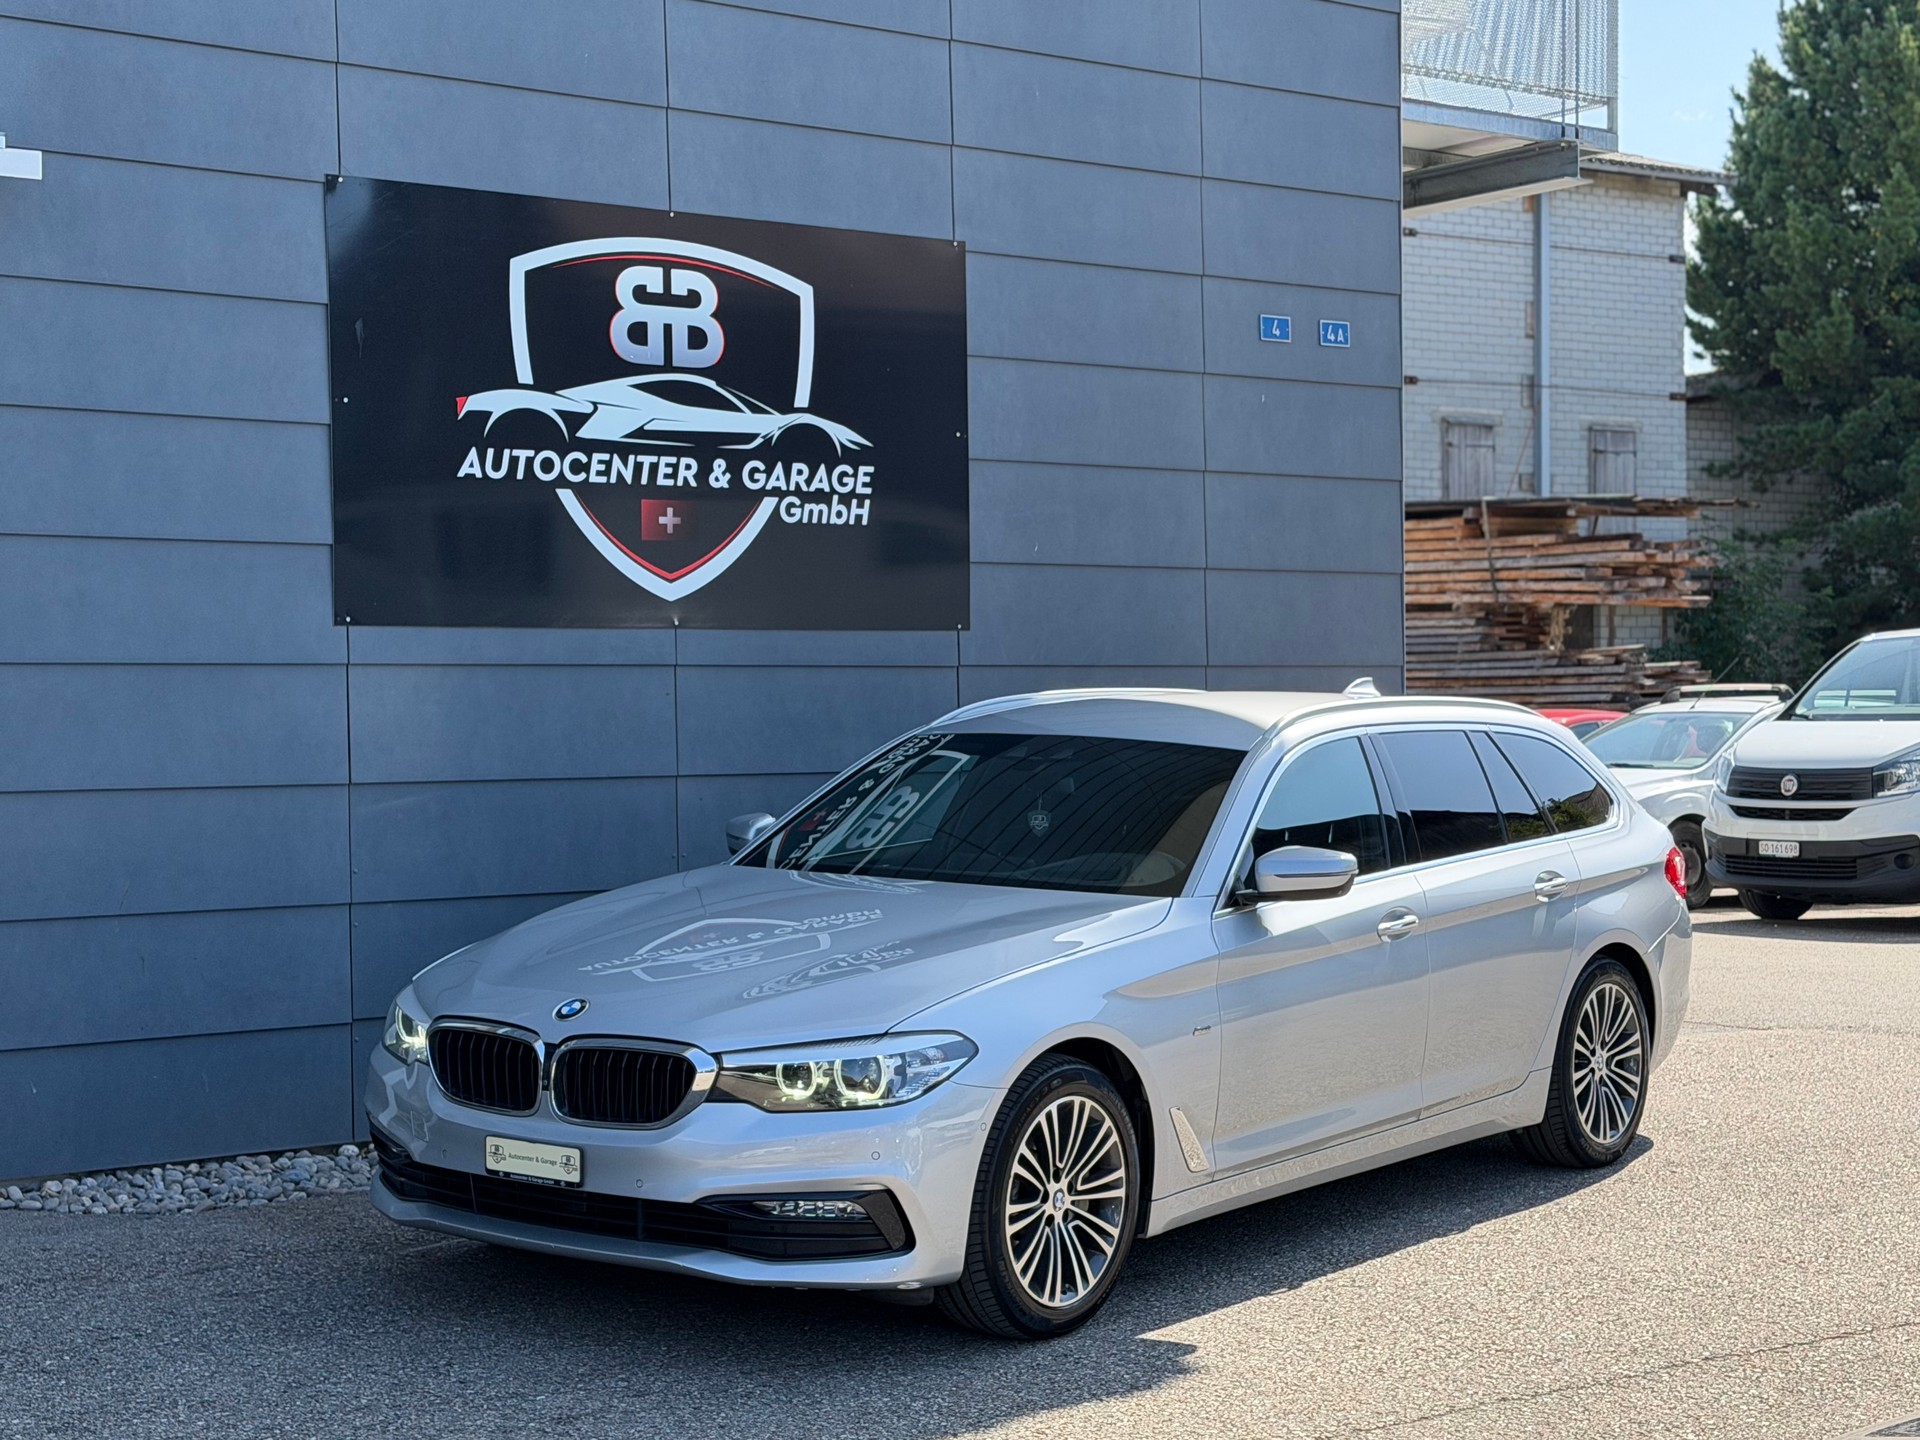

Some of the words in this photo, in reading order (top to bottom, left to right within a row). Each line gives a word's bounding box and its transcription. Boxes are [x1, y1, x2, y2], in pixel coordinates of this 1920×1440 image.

[1272, 319, 1280, 336] 4
[1327, 324, 1345, 343] 4A
[456, 446, 698, 488] AUTOCENTER
[708, 458, 732, 489] &
[741, 459, 875, 495] GARAGE
[779, 494, 871, 526] GmbH
[540, 1156, 558, 1167] Garage
